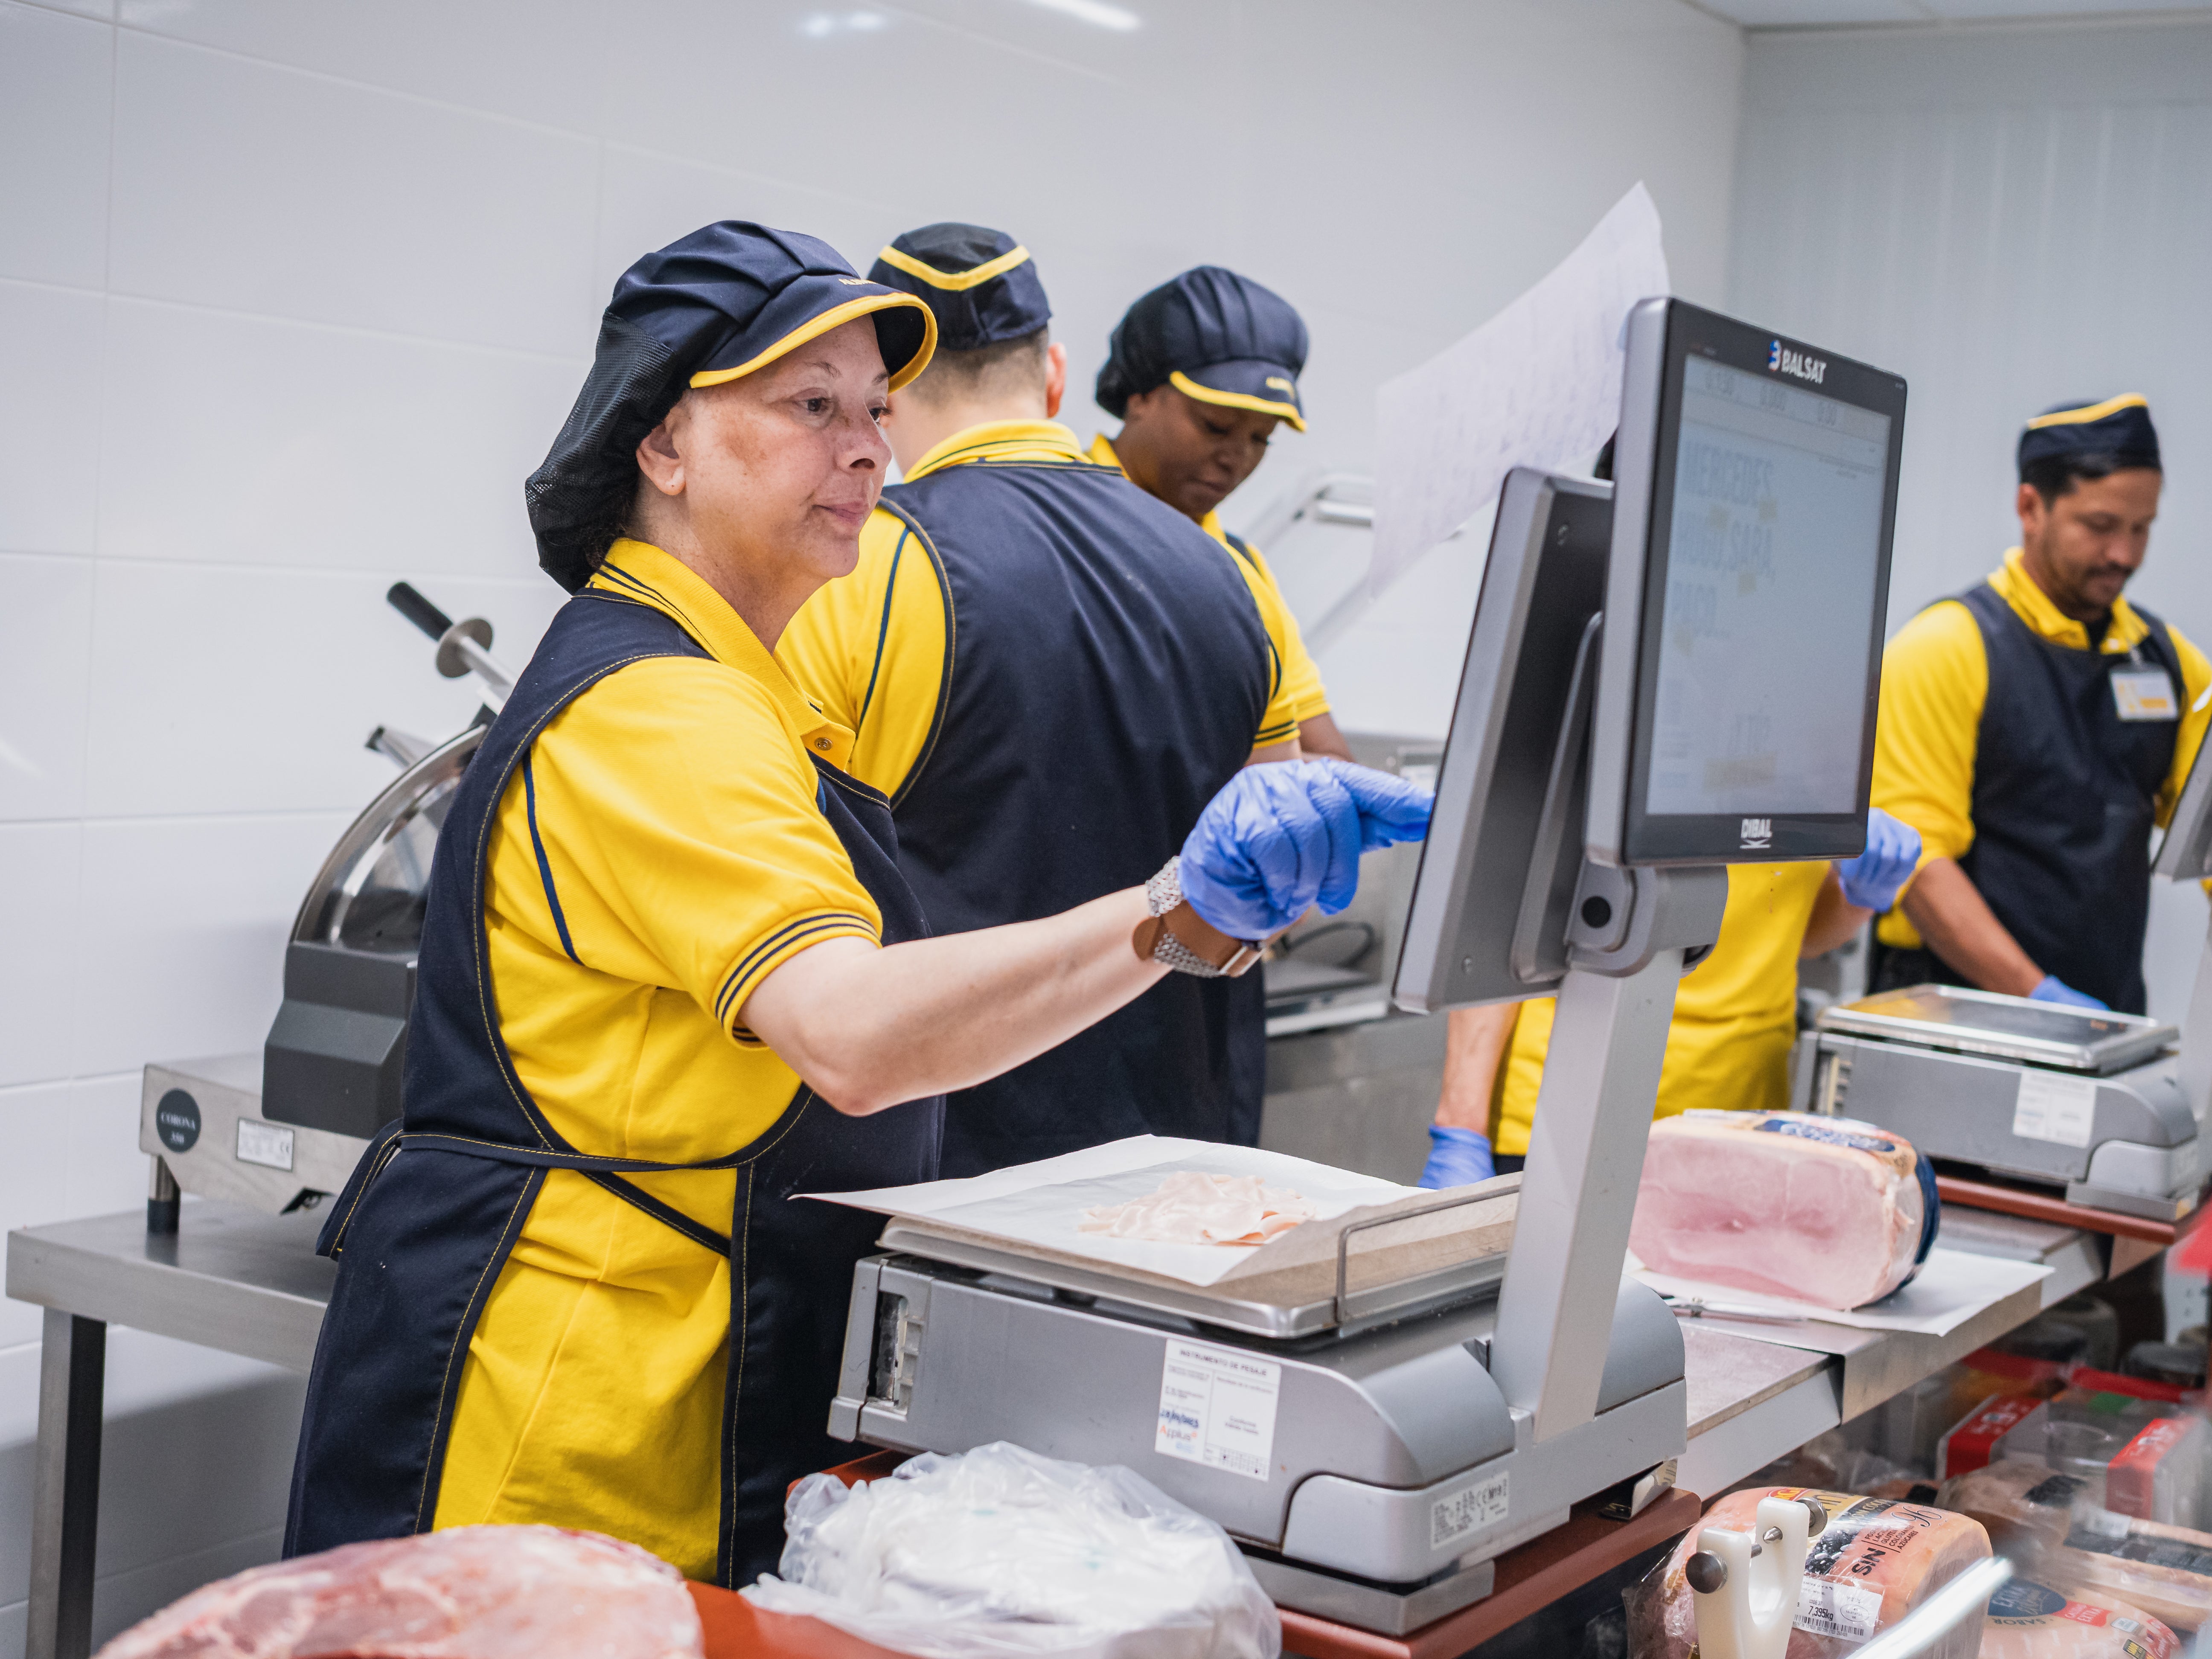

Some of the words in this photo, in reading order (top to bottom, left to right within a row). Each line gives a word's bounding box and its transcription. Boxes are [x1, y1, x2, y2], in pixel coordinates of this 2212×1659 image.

[1781, 348, 1827, 385] BALSAT
[1180, 1350, 1228, 1366] INSTRUMENTO
[1230, 1360, 1239, 1369] DE
[1241, 1363, 1267, 1376] PESAJE
[1881, 1529, 1898, 1544] GLUTEN
[1889, 1525, 1915, 1546] COLORANTES
[1897, 1530, 1919, 1550] AZÚCARES
[1851, 1547, 1886, 1576] SIN
